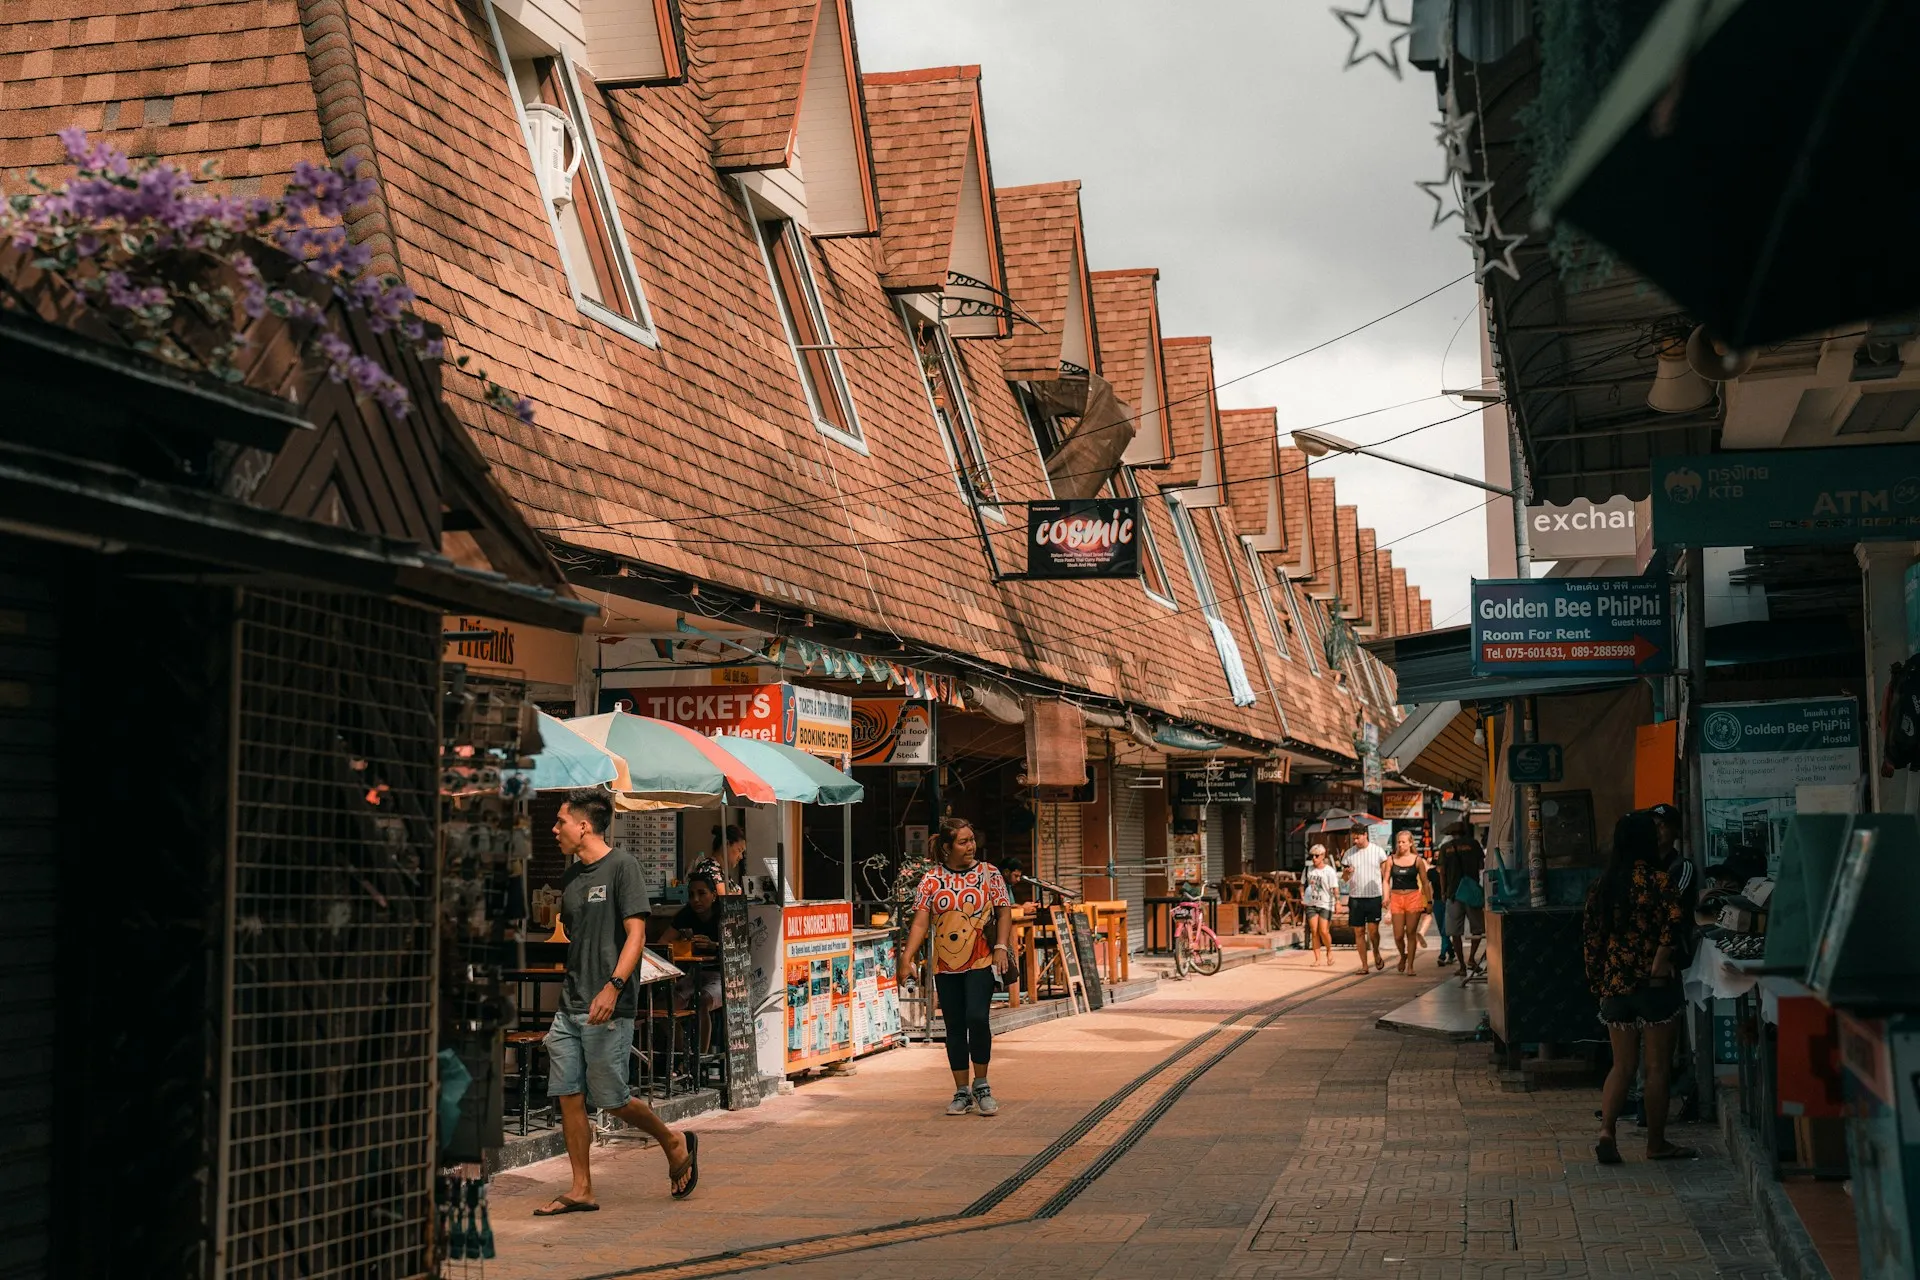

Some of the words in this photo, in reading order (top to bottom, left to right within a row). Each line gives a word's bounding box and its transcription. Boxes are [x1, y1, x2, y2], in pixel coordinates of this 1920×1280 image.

[1708, 485, 1745, 499] KTB
[1812, 489, 1889, 516] ATM
[1479, 598, 1549, 620] Golden
[1554, 597, 1592, 618] Bee
[1597, 595, 1661, 617] PhiPhi
[1611, 619, 1635, 627] Guest
[1636, 618, 1662, 626] House
[458, 618, 515, 665] Friends
[1482, 630, 1524, 641] Room
[1528, 629, 1552, 640] For
[1556, 628, 1591, 639] Rent
[1486, 648, 1503, 659] Tel.
[1505, 647, 1566, 660] 075-601431,
[1571, 645, 1636, 658] 089-2885998
[647, 692, 772, 721] TICKETS
[1744, 723, 1785, 736] Golden
[1787, 721, 1810, 734] Bee
[1812, 718, 1851, 732] PhiPhi
[799, 727, 827, 748] BOOKING
[827, 730, 849, 749] CENTER
[1822, 733, 1851, 744] Hostel
[943, 871, 977, 889] the
[787, 915, 803, 937] DAILY
[803, 913, 835, 937] SNORKELING
[835, 912, 849, 933] TOUR
